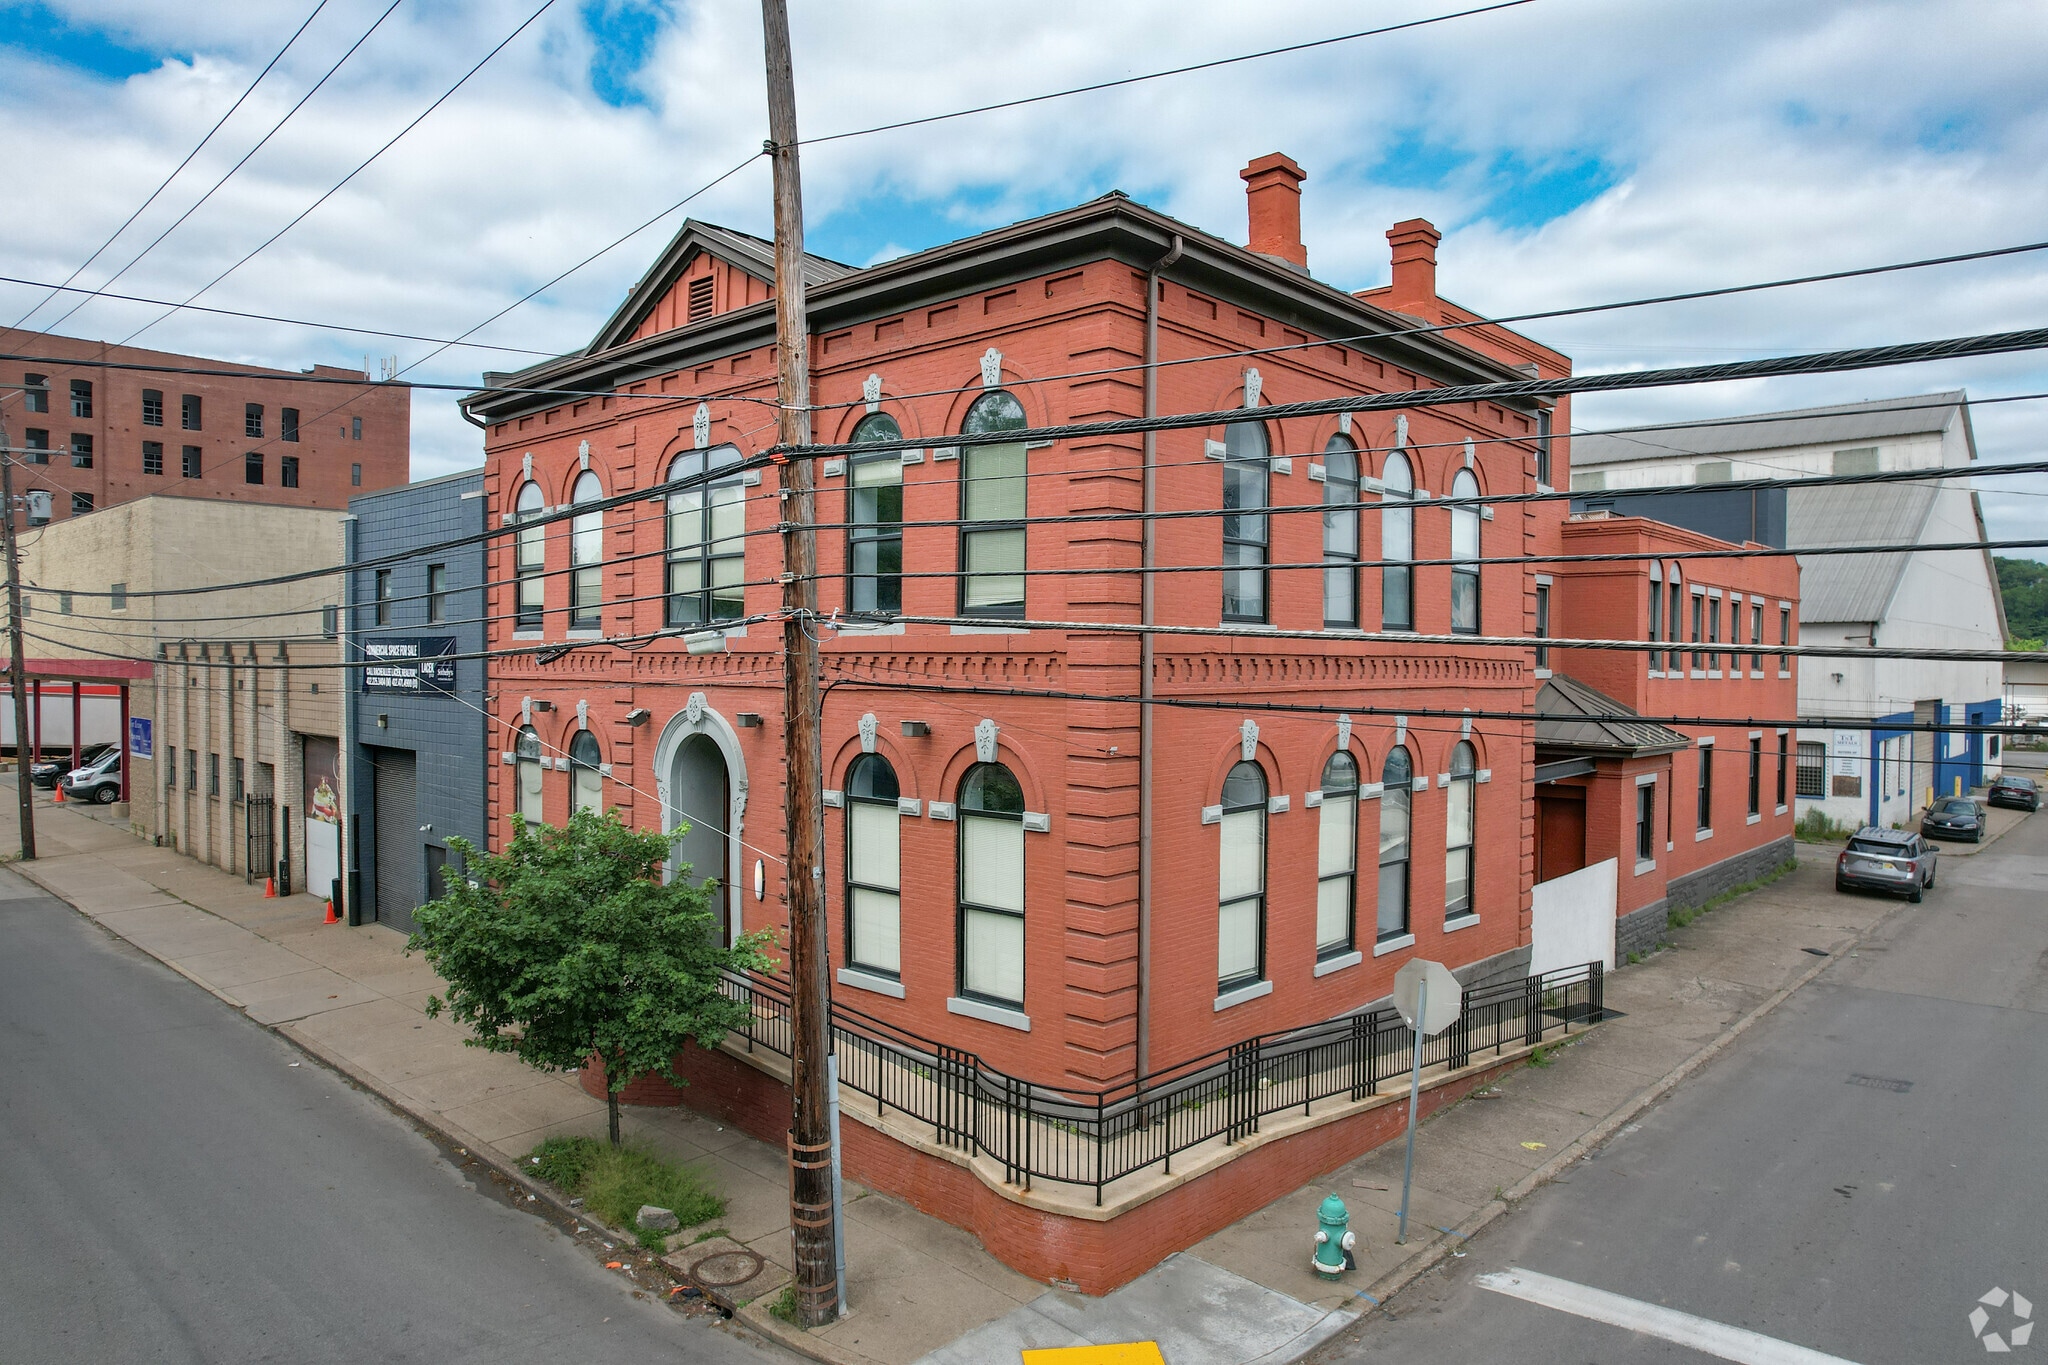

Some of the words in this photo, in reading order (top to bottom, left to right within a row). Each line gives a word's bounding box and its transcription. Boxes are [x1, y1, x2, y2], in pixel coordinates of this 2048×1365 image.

[366, 645, 388, 656] COMMERCIAL
[388, 645, 399, 656] SPACE
[408, 645, 417, 656] SALE
[421, 662, 434, 673] LACEK
